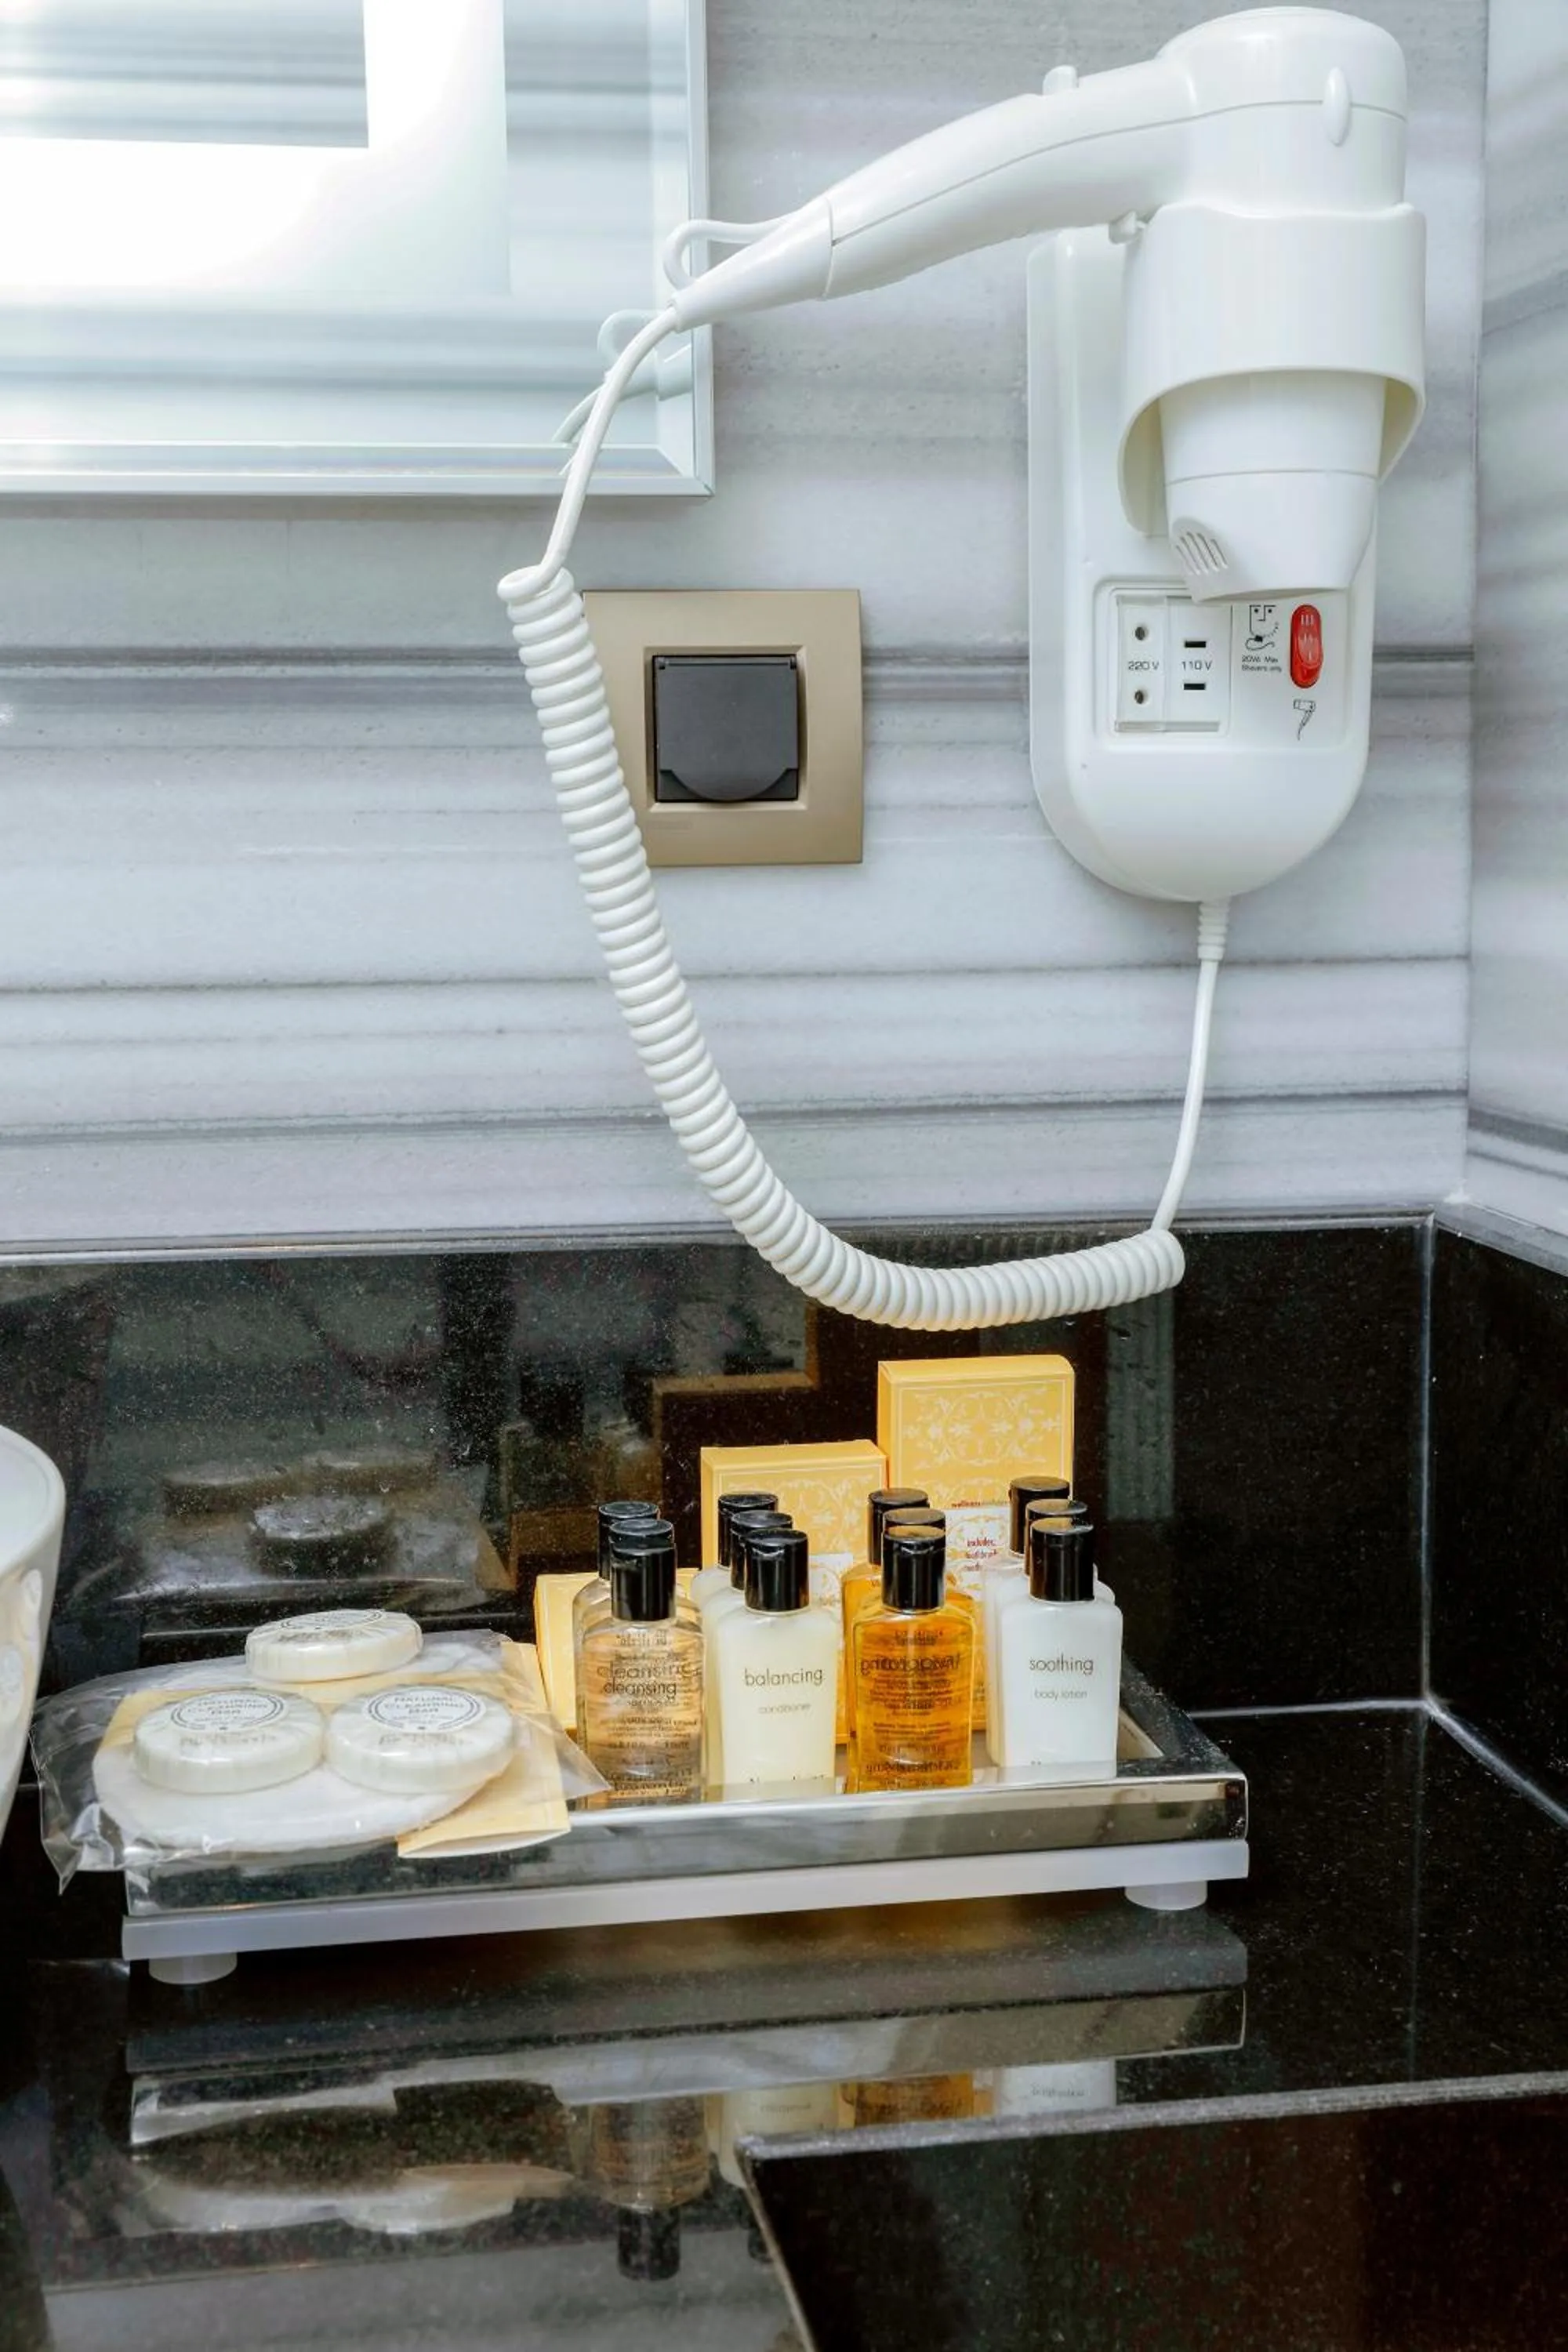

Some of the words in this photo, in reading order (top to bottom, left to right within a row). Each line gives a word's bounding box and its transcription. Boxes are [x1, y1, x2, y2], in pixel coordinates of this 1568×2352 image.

[1128, 660, 1149, 670] 220
[1152, 660, 1160, 670] V
[1181, 660, 1202, 671] 110
[1204, 660, 1213, 671] V
[1029, 1652, 1094, 1675] soothing
[744, 1668, 823, 1686] balancing
[604, 1675, 677, 1697] cleansing
[1034, 1688, 1058, 1700] body
[1061, 1688, 1088, 1700] lotion
